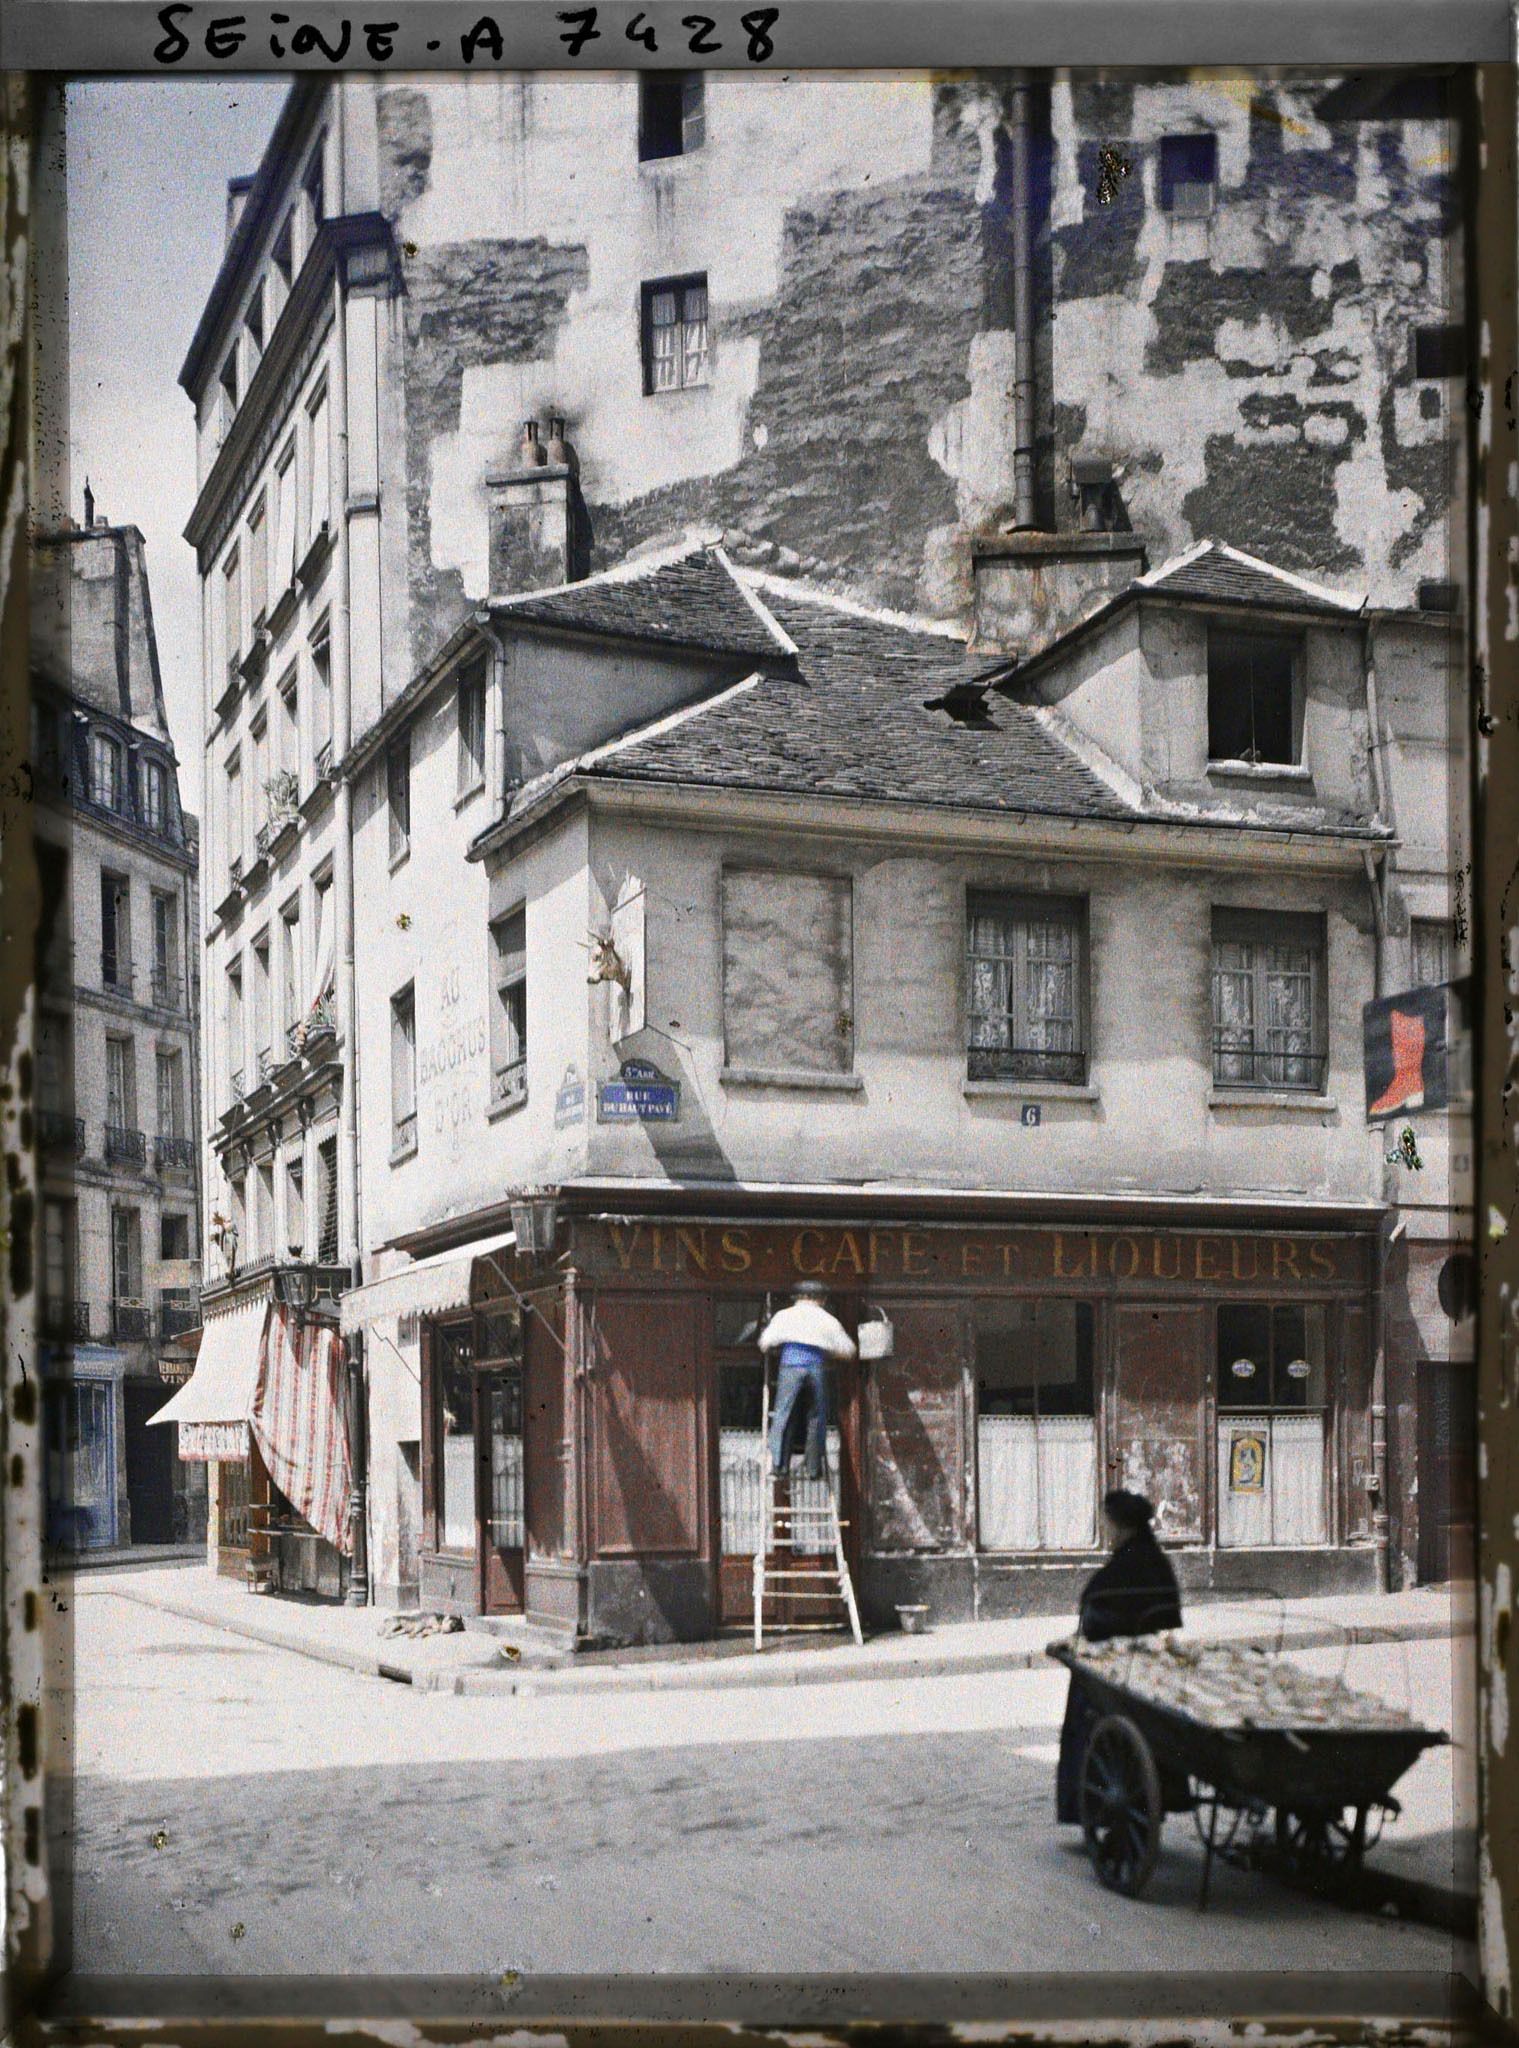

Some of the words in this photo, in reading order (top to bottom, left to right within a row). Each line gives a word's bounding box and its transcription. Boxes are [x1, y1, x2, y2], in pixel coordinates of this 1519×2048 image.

[556, 7, 779, 62] 7428
[626, 1090, 651, 1101] RUE
[603, 1102, 617, 1112] DU
[619, 1102, 646, 1114] HAUT
[1026, 1107, 1036, 1126] 6
[609, 1225, 751, 1272] VINS
[962, 1244, 1020, 1277] ET
[1052, 1233, 1337, 1282] LIQUEURS
